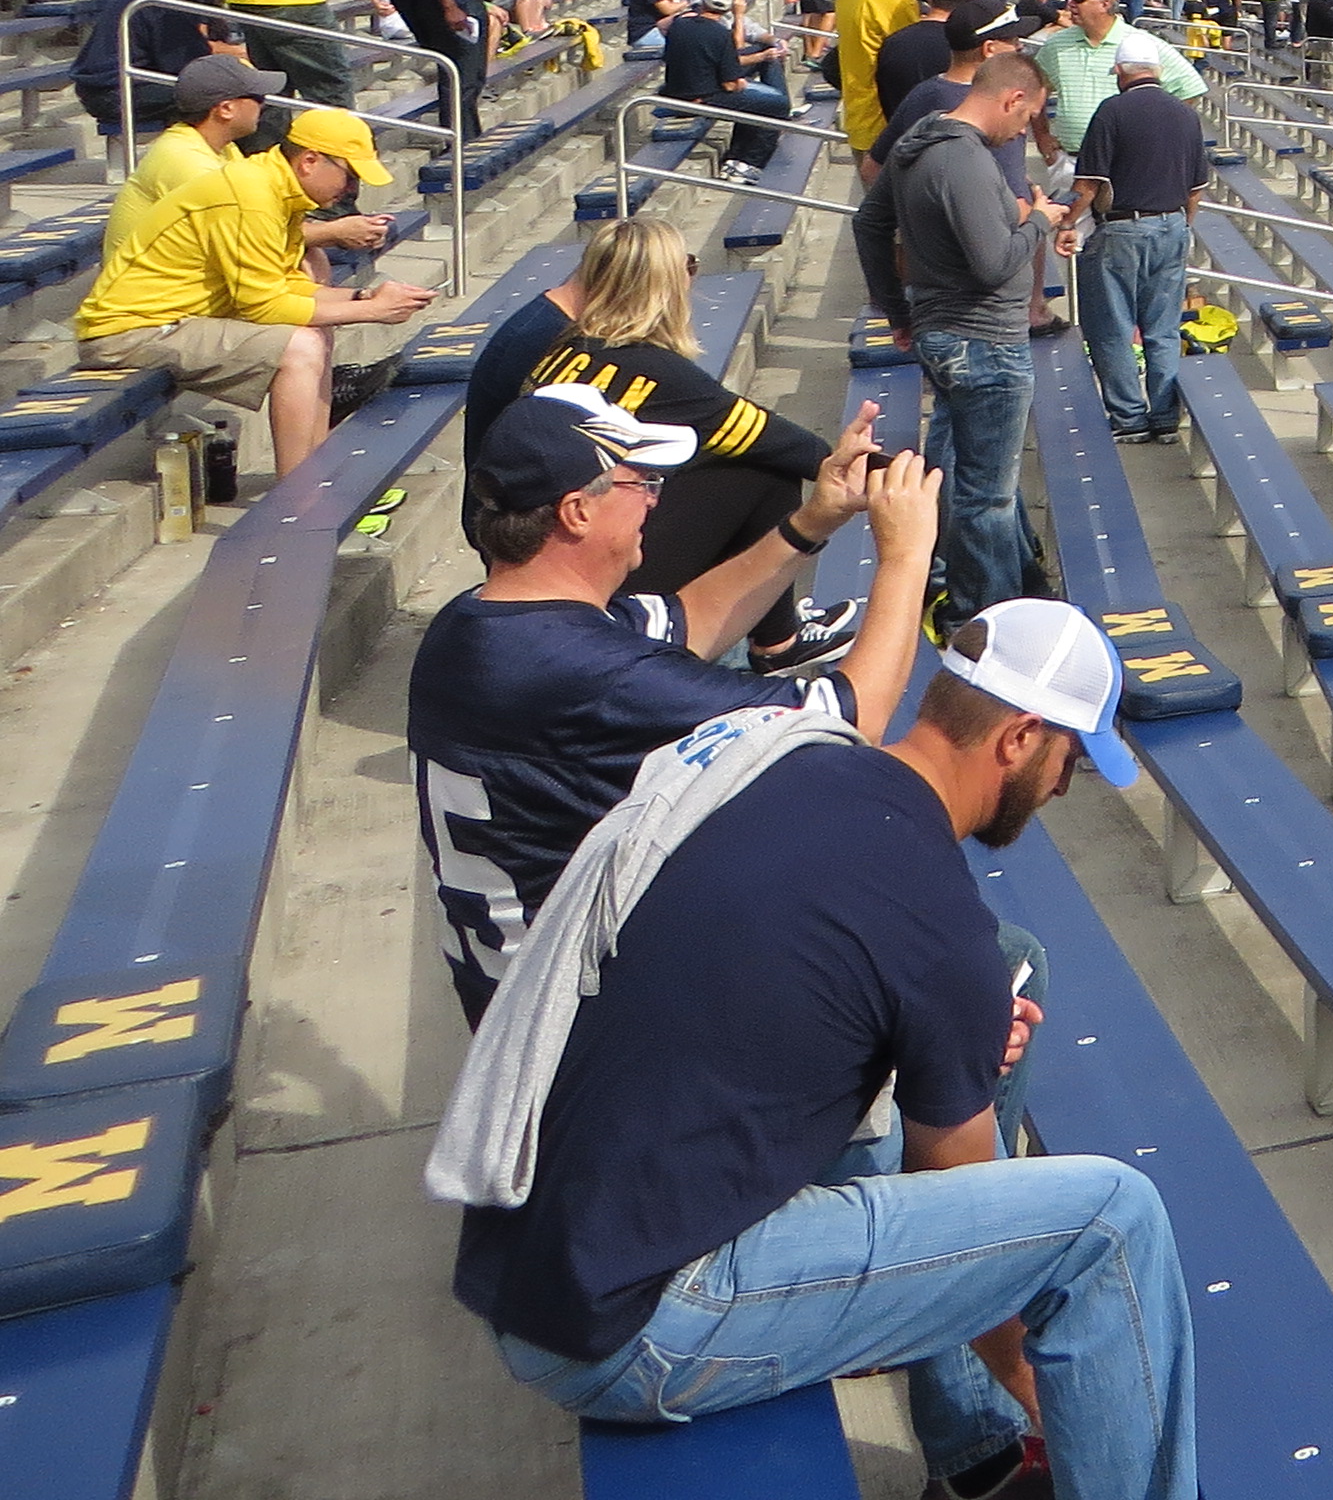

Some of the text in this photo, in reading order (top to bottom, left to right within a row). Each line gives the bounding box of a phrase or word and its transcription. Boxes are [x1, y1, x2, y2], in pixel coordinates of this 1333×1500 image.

[1102, 608, 1174, 637] M
[1124, 651, 1211, 683] M
[43, 976, 203, 1065] M
[1077, 1036, 1097, 1045] 6
[0, 1115, 153, 1223] M
[1206, 1280, 1233, 1293] 8
[1293, 1446, 1320, 1461] 9
